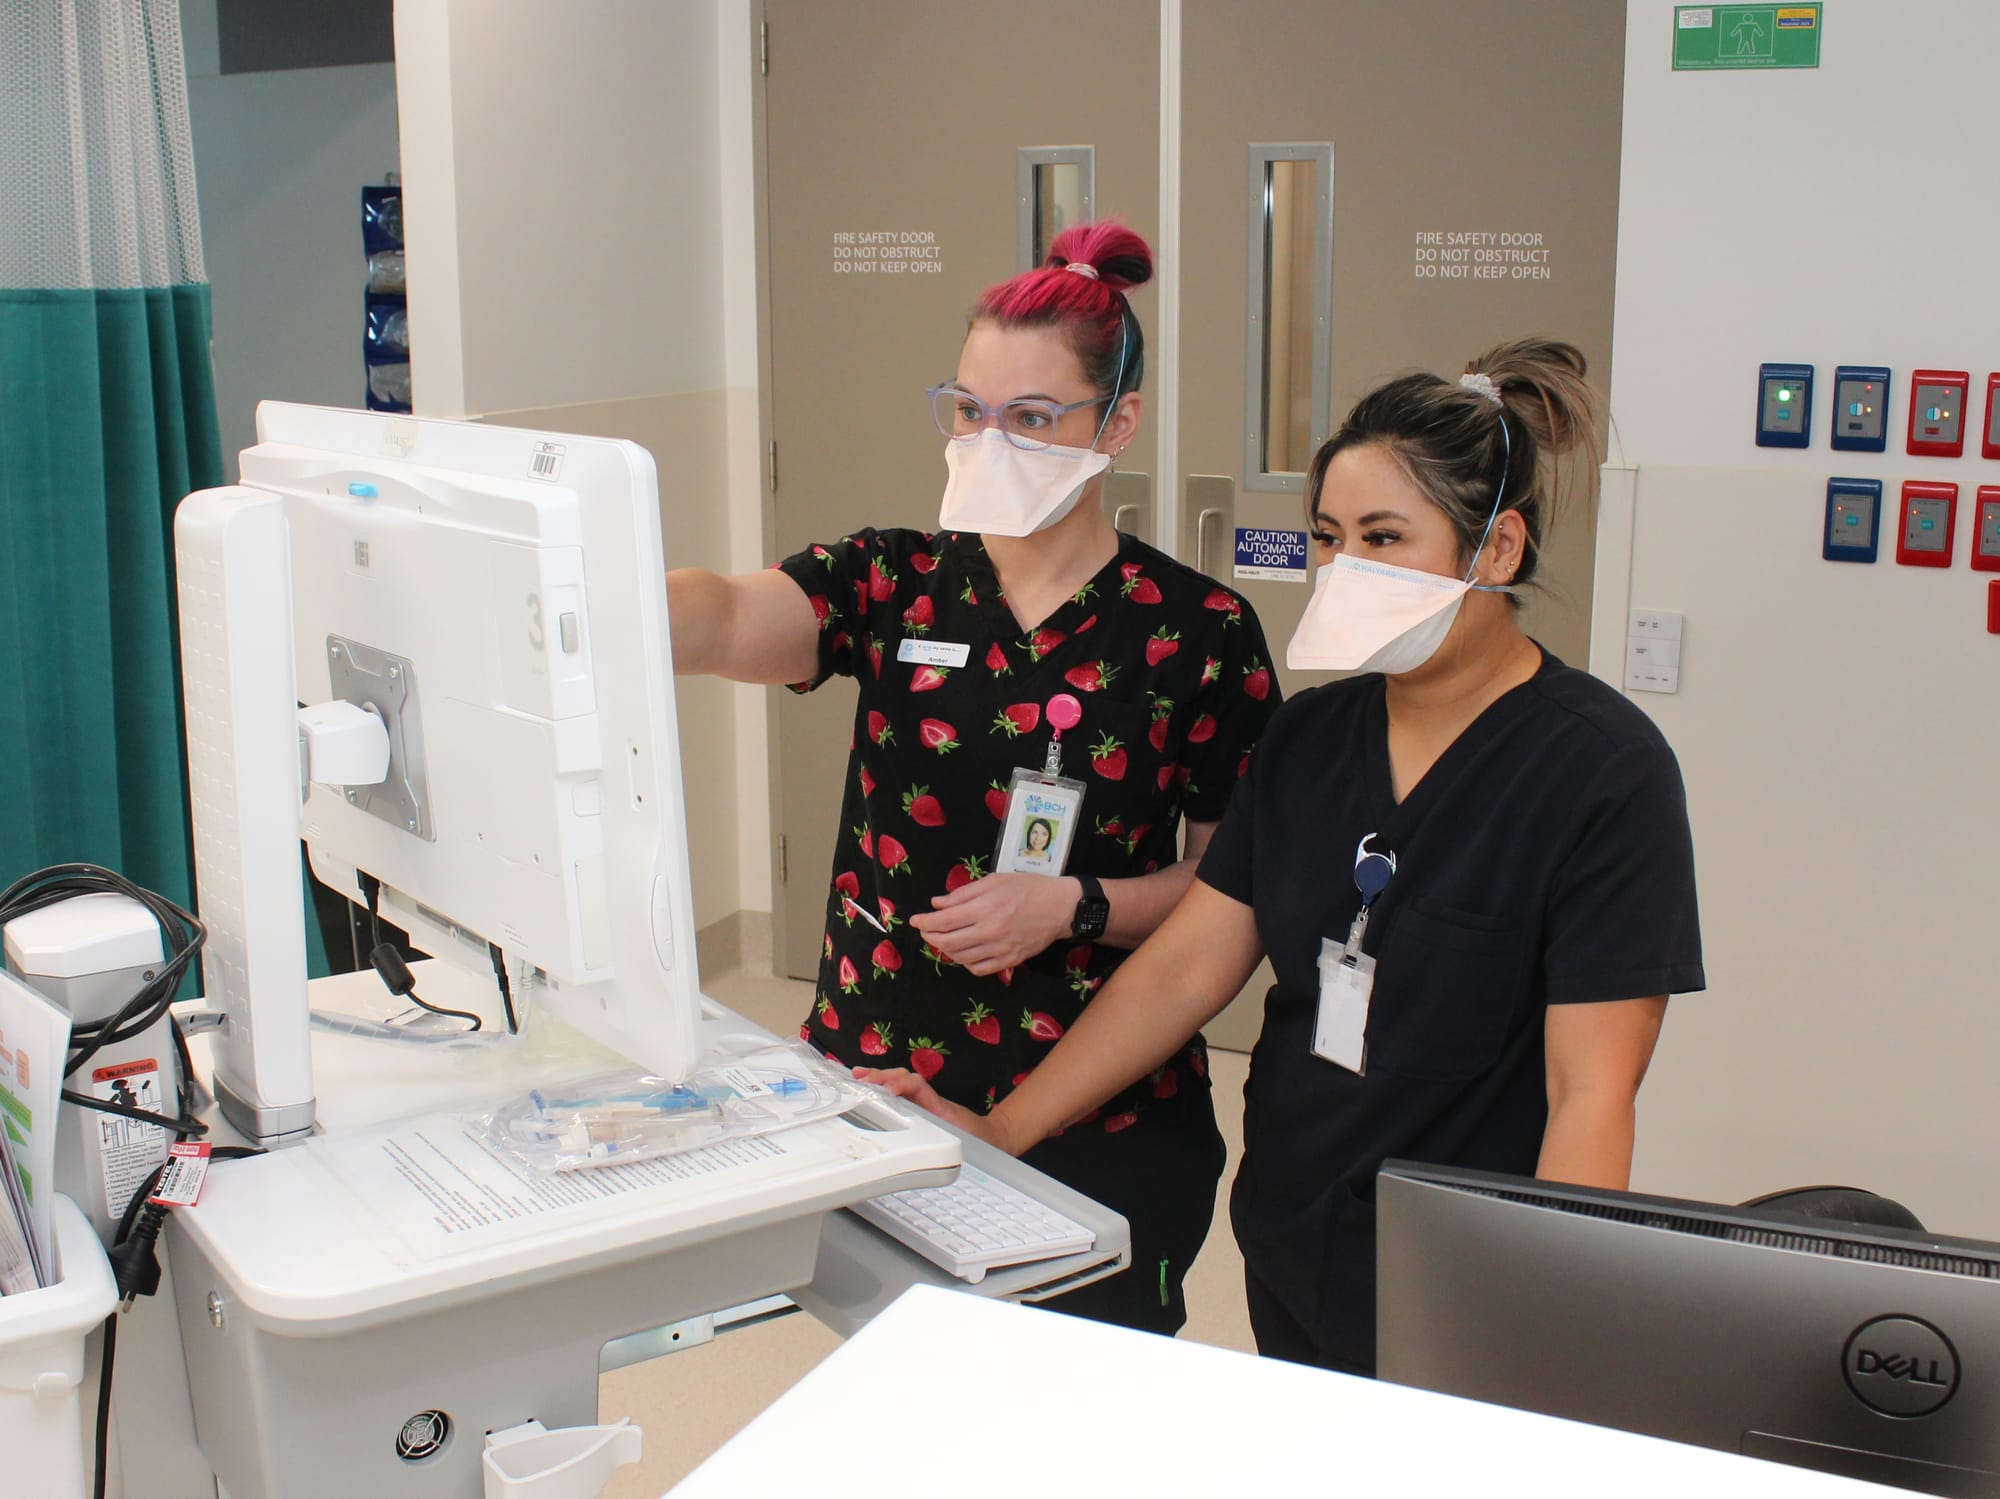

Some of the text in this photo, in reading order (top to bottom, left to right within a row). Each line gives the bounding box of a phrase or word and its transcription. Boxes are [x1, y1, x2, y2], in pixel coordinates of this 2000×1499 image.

[834, 231, 935, 244] FIRE SAFETY DOOR
[1416, 232, 1543, 246] FIRE SAFETY DOOR
[834, 246, 941, 258] DO NOT OBSTRUCT
[1415, 248, 1550, 263] DO NOT OBSTRUCT
[834, 261, 942, 273] DO NOT KEEP OPEN
[1415, 264, 1550, 279] DO NOT KEEP OPEN
[1245, 530, 1298, 544] CAUTION
[1237, 541, 1305, 556] AUTOMATIC
[1253, 553, 1289, 566] DOOR
[1043, 801, 1066, 814] BCH
[106, 1062, 154, 1078] WARNING
[1856, 1348, 1948, 1387] DELL
